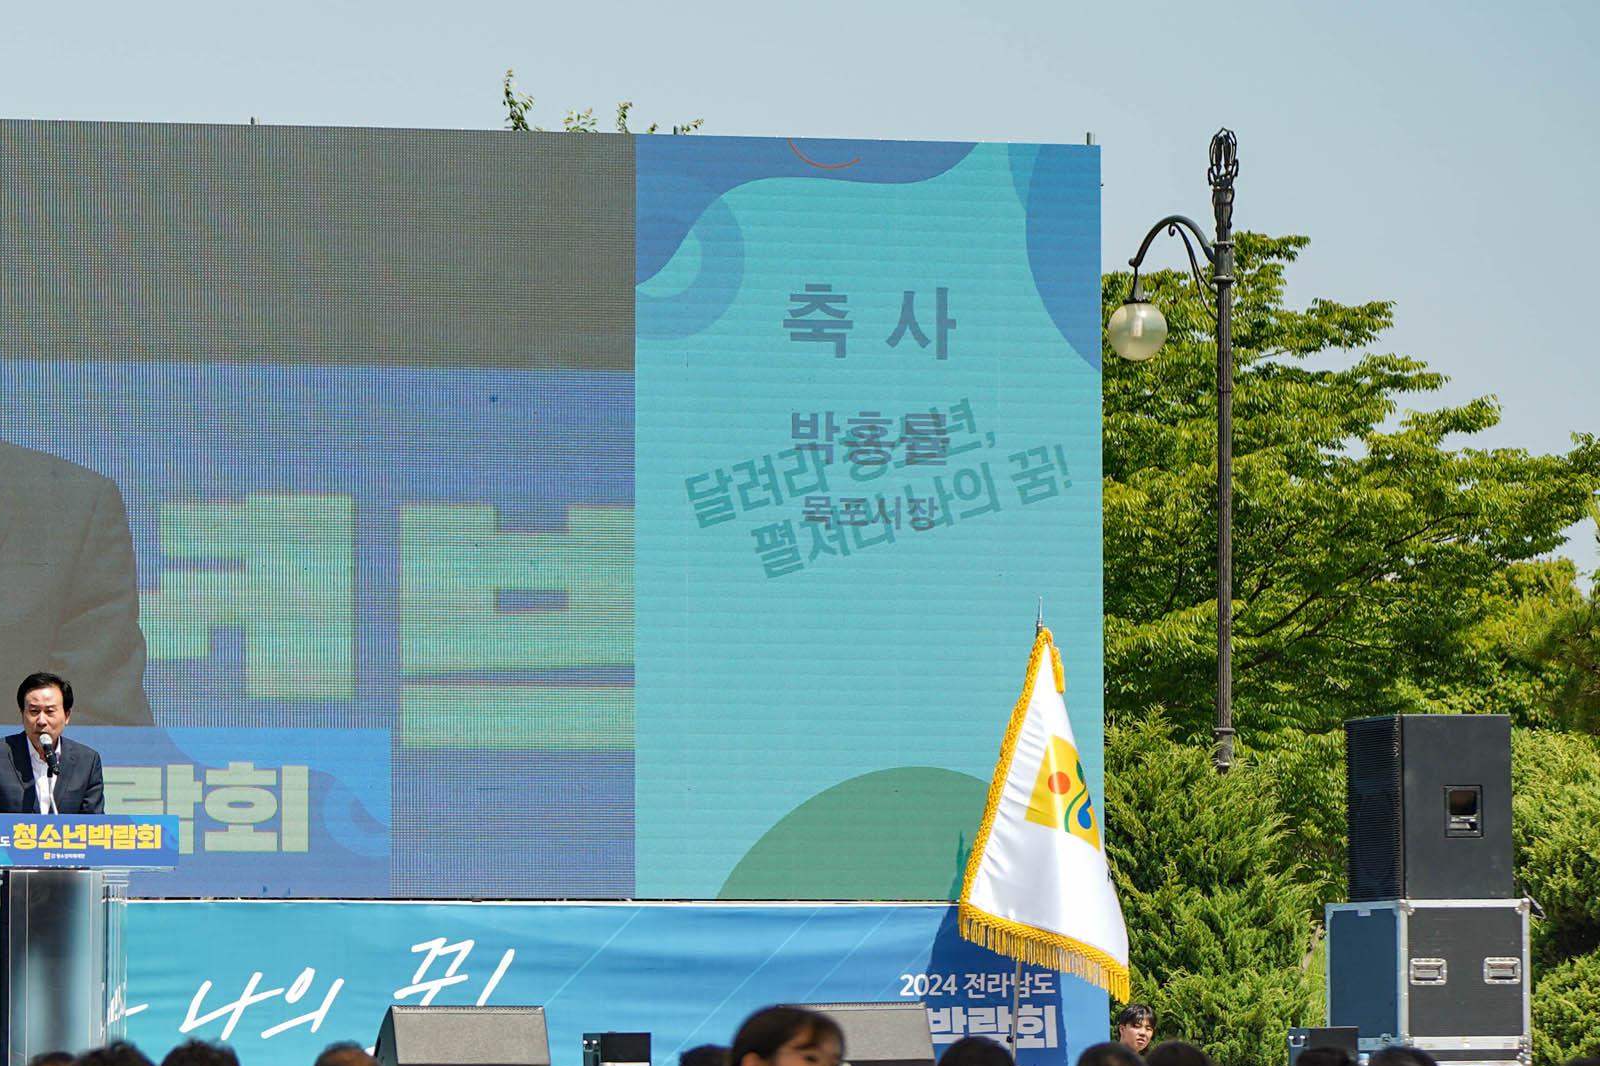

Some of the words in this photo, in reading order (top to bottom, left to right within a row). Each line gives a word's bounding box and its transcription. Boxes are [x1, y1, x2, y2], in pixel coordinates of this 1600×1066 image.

[791, 411, 950, 466] 박홍률
[684, 442, 830, 529] 달려라
[1008, 444, 1073, 505] 꿈!
[802, 496, 939, 531] 목포시장
[12, 823, 162, 850] 청소년박람회
[179, 967, 345, 1040] 나의
[900, 973, 958, 997] 2024
[963, 972, 1056, 999] 전라남도
